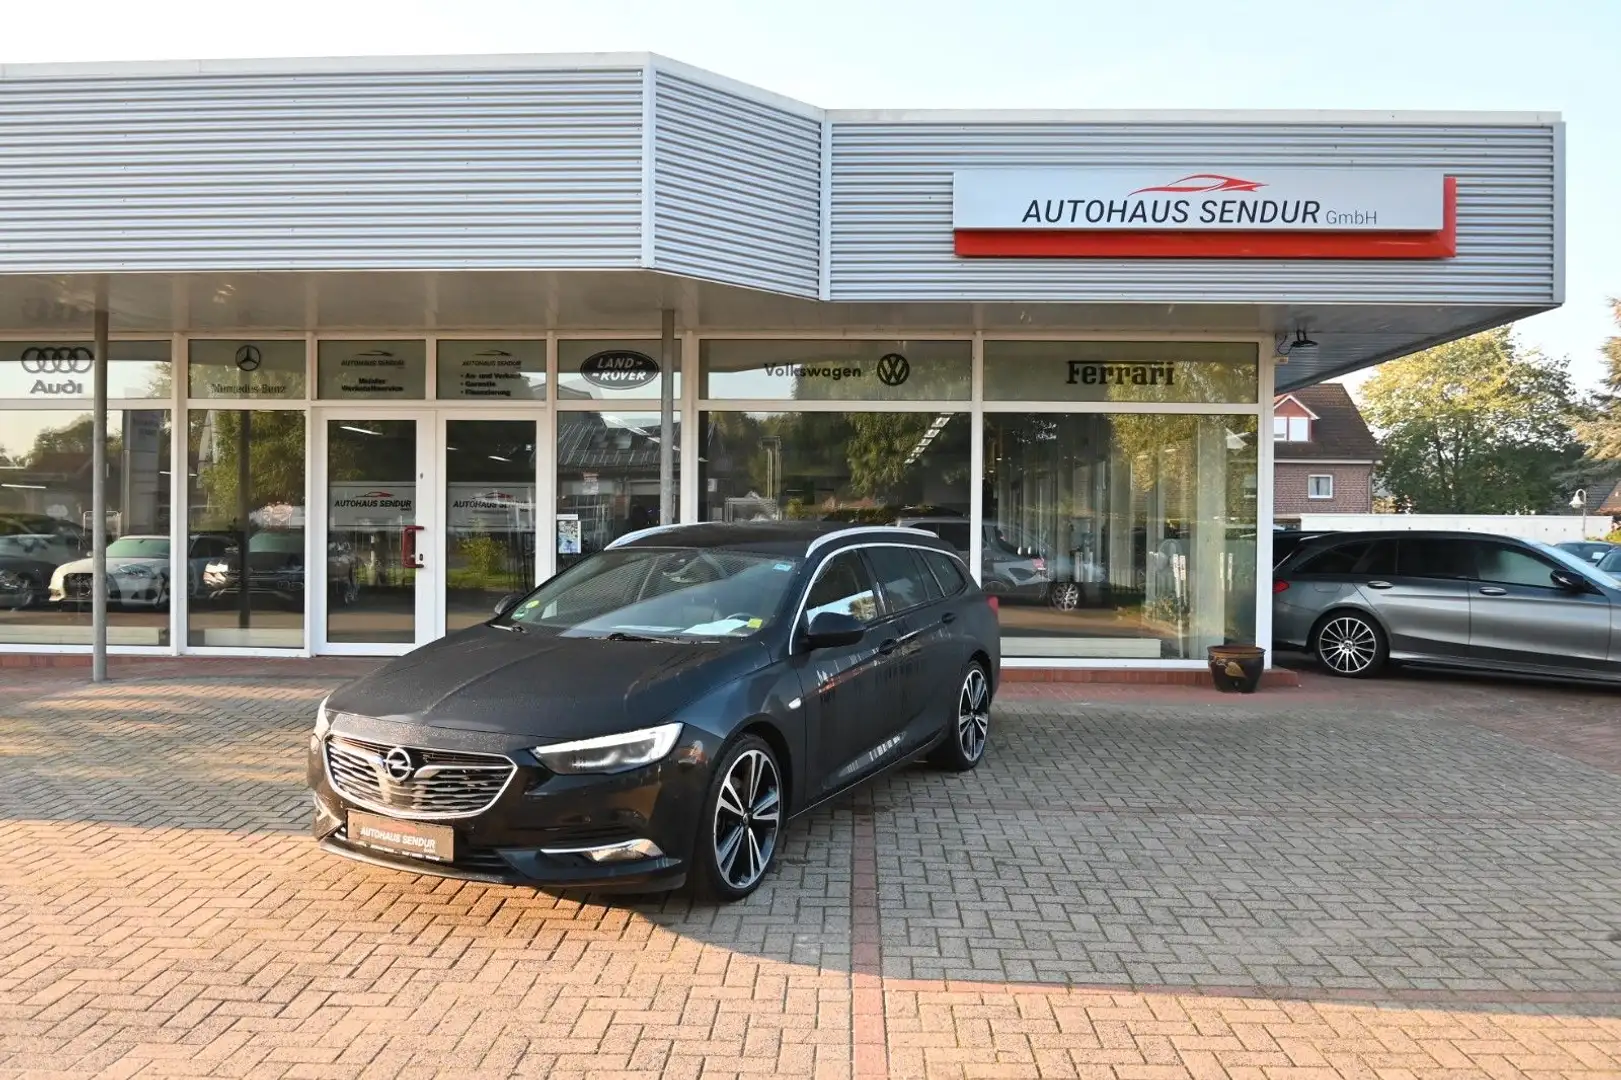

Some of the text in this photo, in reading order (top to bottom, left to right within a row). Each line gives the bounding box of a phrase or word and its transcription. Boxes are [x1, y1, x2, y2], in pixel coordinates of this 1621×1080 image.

[1022, 200, 1377, 225] AUTOHAUS SENDUR GmbH
[597, 358, 635, 369] LAND
[600, 371, 647, 381] ROVER
[764, 364, 862, 380] Volkswagen
[1066, 360, 1175, 385] Ferrari
[30, 379, 83, 394] Audi
[360, 827, 436, 849] AUTOHAUS SENDUR
